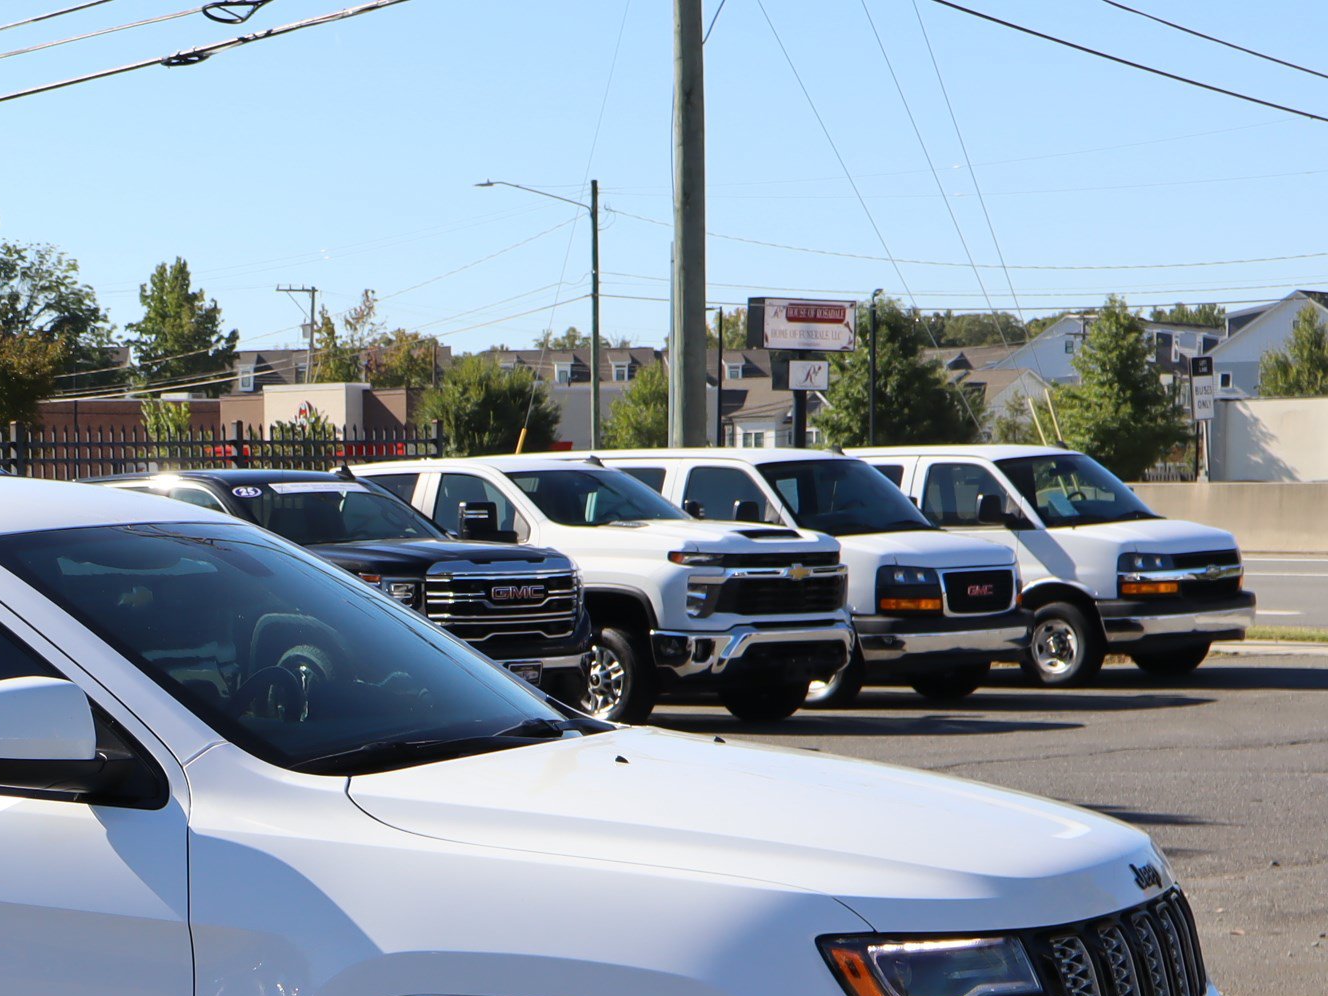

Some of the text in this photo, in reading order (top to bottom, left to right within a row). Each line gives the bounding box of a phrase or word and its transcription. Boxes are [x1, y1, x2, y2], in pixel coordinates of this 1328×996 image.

[787, 307, 807, 318] HOUSE
[807, 307, 815, 318] OF
[1197, 400, 1211, 409] ONLY
[239, 487, 256, 496] 25
[492, 584, 545, 600] GMC
[967, 584, 993, 596] GMC
[1128, 863, 1162, 890] Jeep
